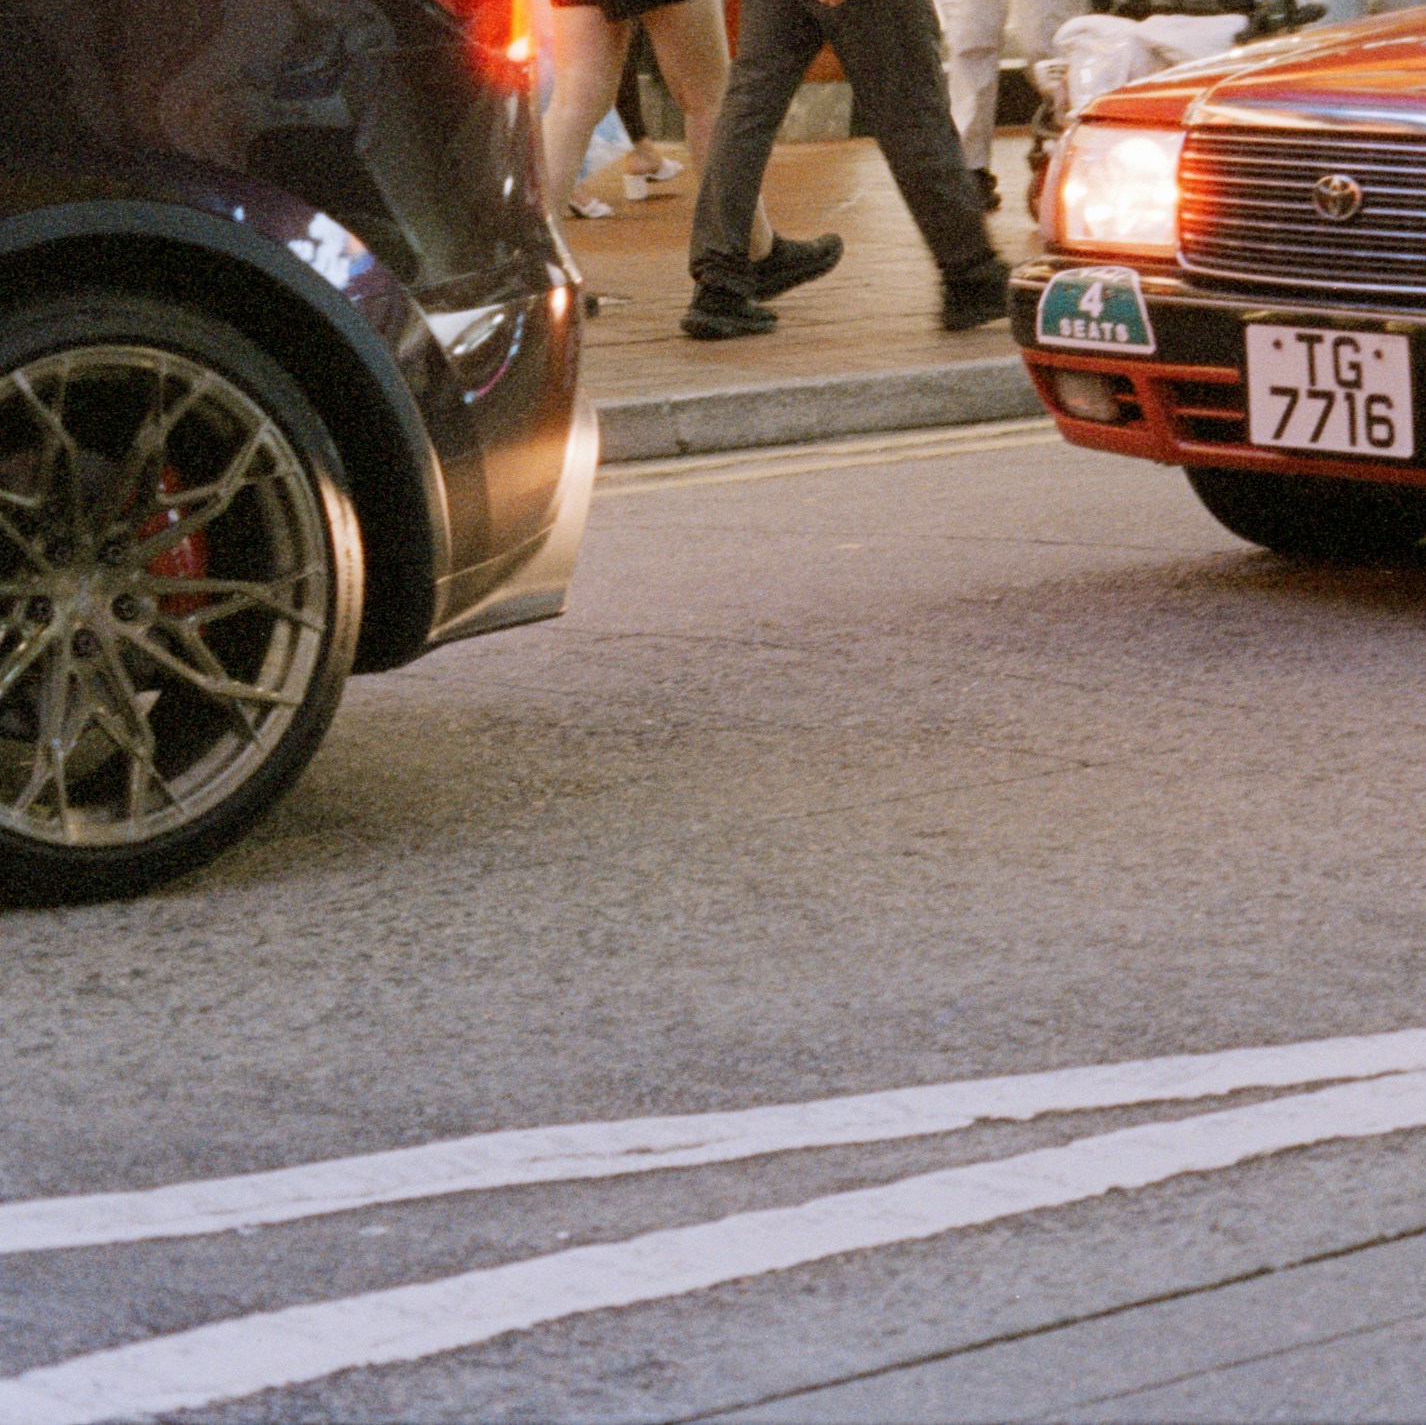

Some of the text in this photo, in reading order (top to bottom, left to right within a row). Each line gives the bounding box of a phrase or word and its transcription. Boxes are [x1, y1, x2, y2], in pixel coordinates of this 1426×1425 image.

[1078, 281, 1105, 319] 4
[1059, 317, 1130, 343] SEATS
[1295, 332, 1364, 391] TG
[1268, 388, 1397, 450] 7716
